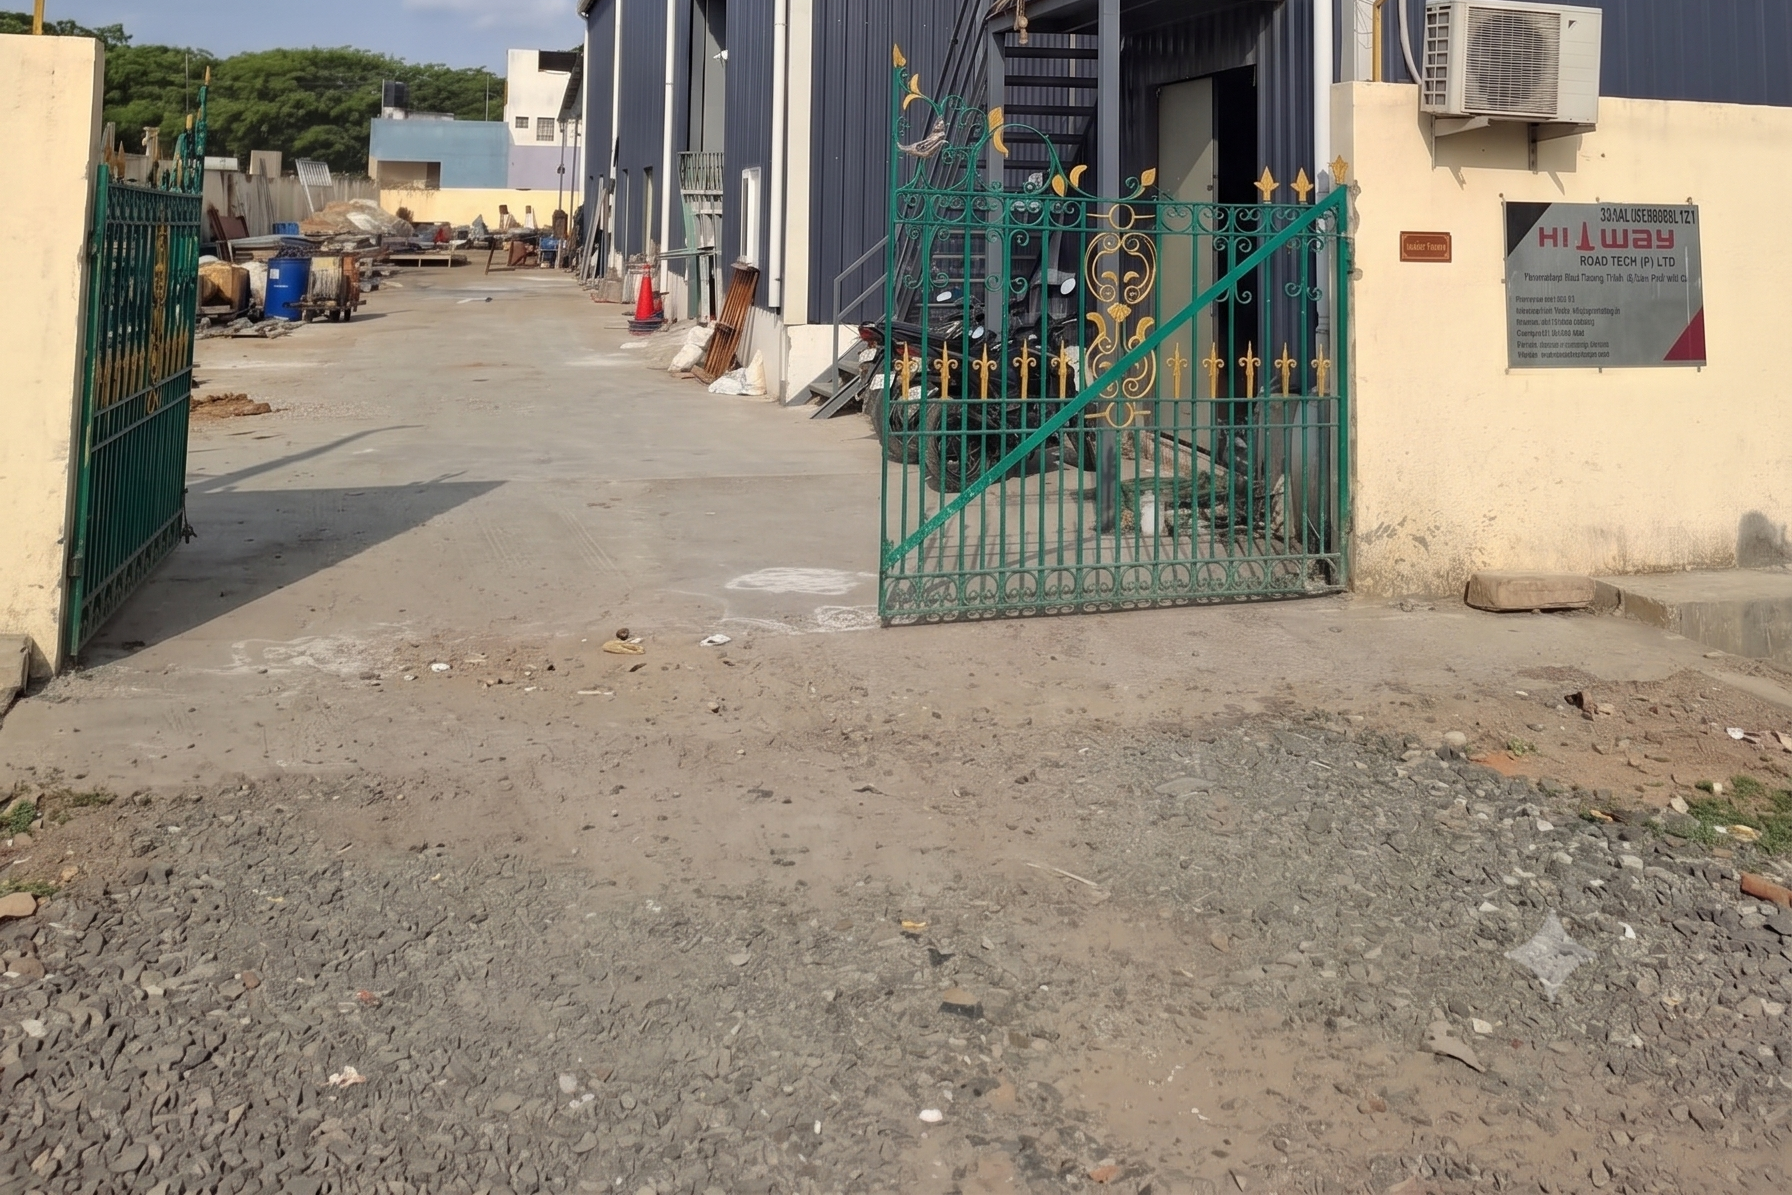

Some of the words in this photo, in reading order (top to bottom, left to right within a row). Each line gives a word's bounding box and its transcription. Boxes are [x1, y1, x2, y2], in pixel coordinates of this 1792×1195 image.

[1538, 226, 1569, 248] HI
[1579, 255, 1608, 267] ROAD
[1611, 256, 1637, 267] TECH
[1640, 256, 1654, 269] (P)
[1657, 256, 1676, 268] LTD
